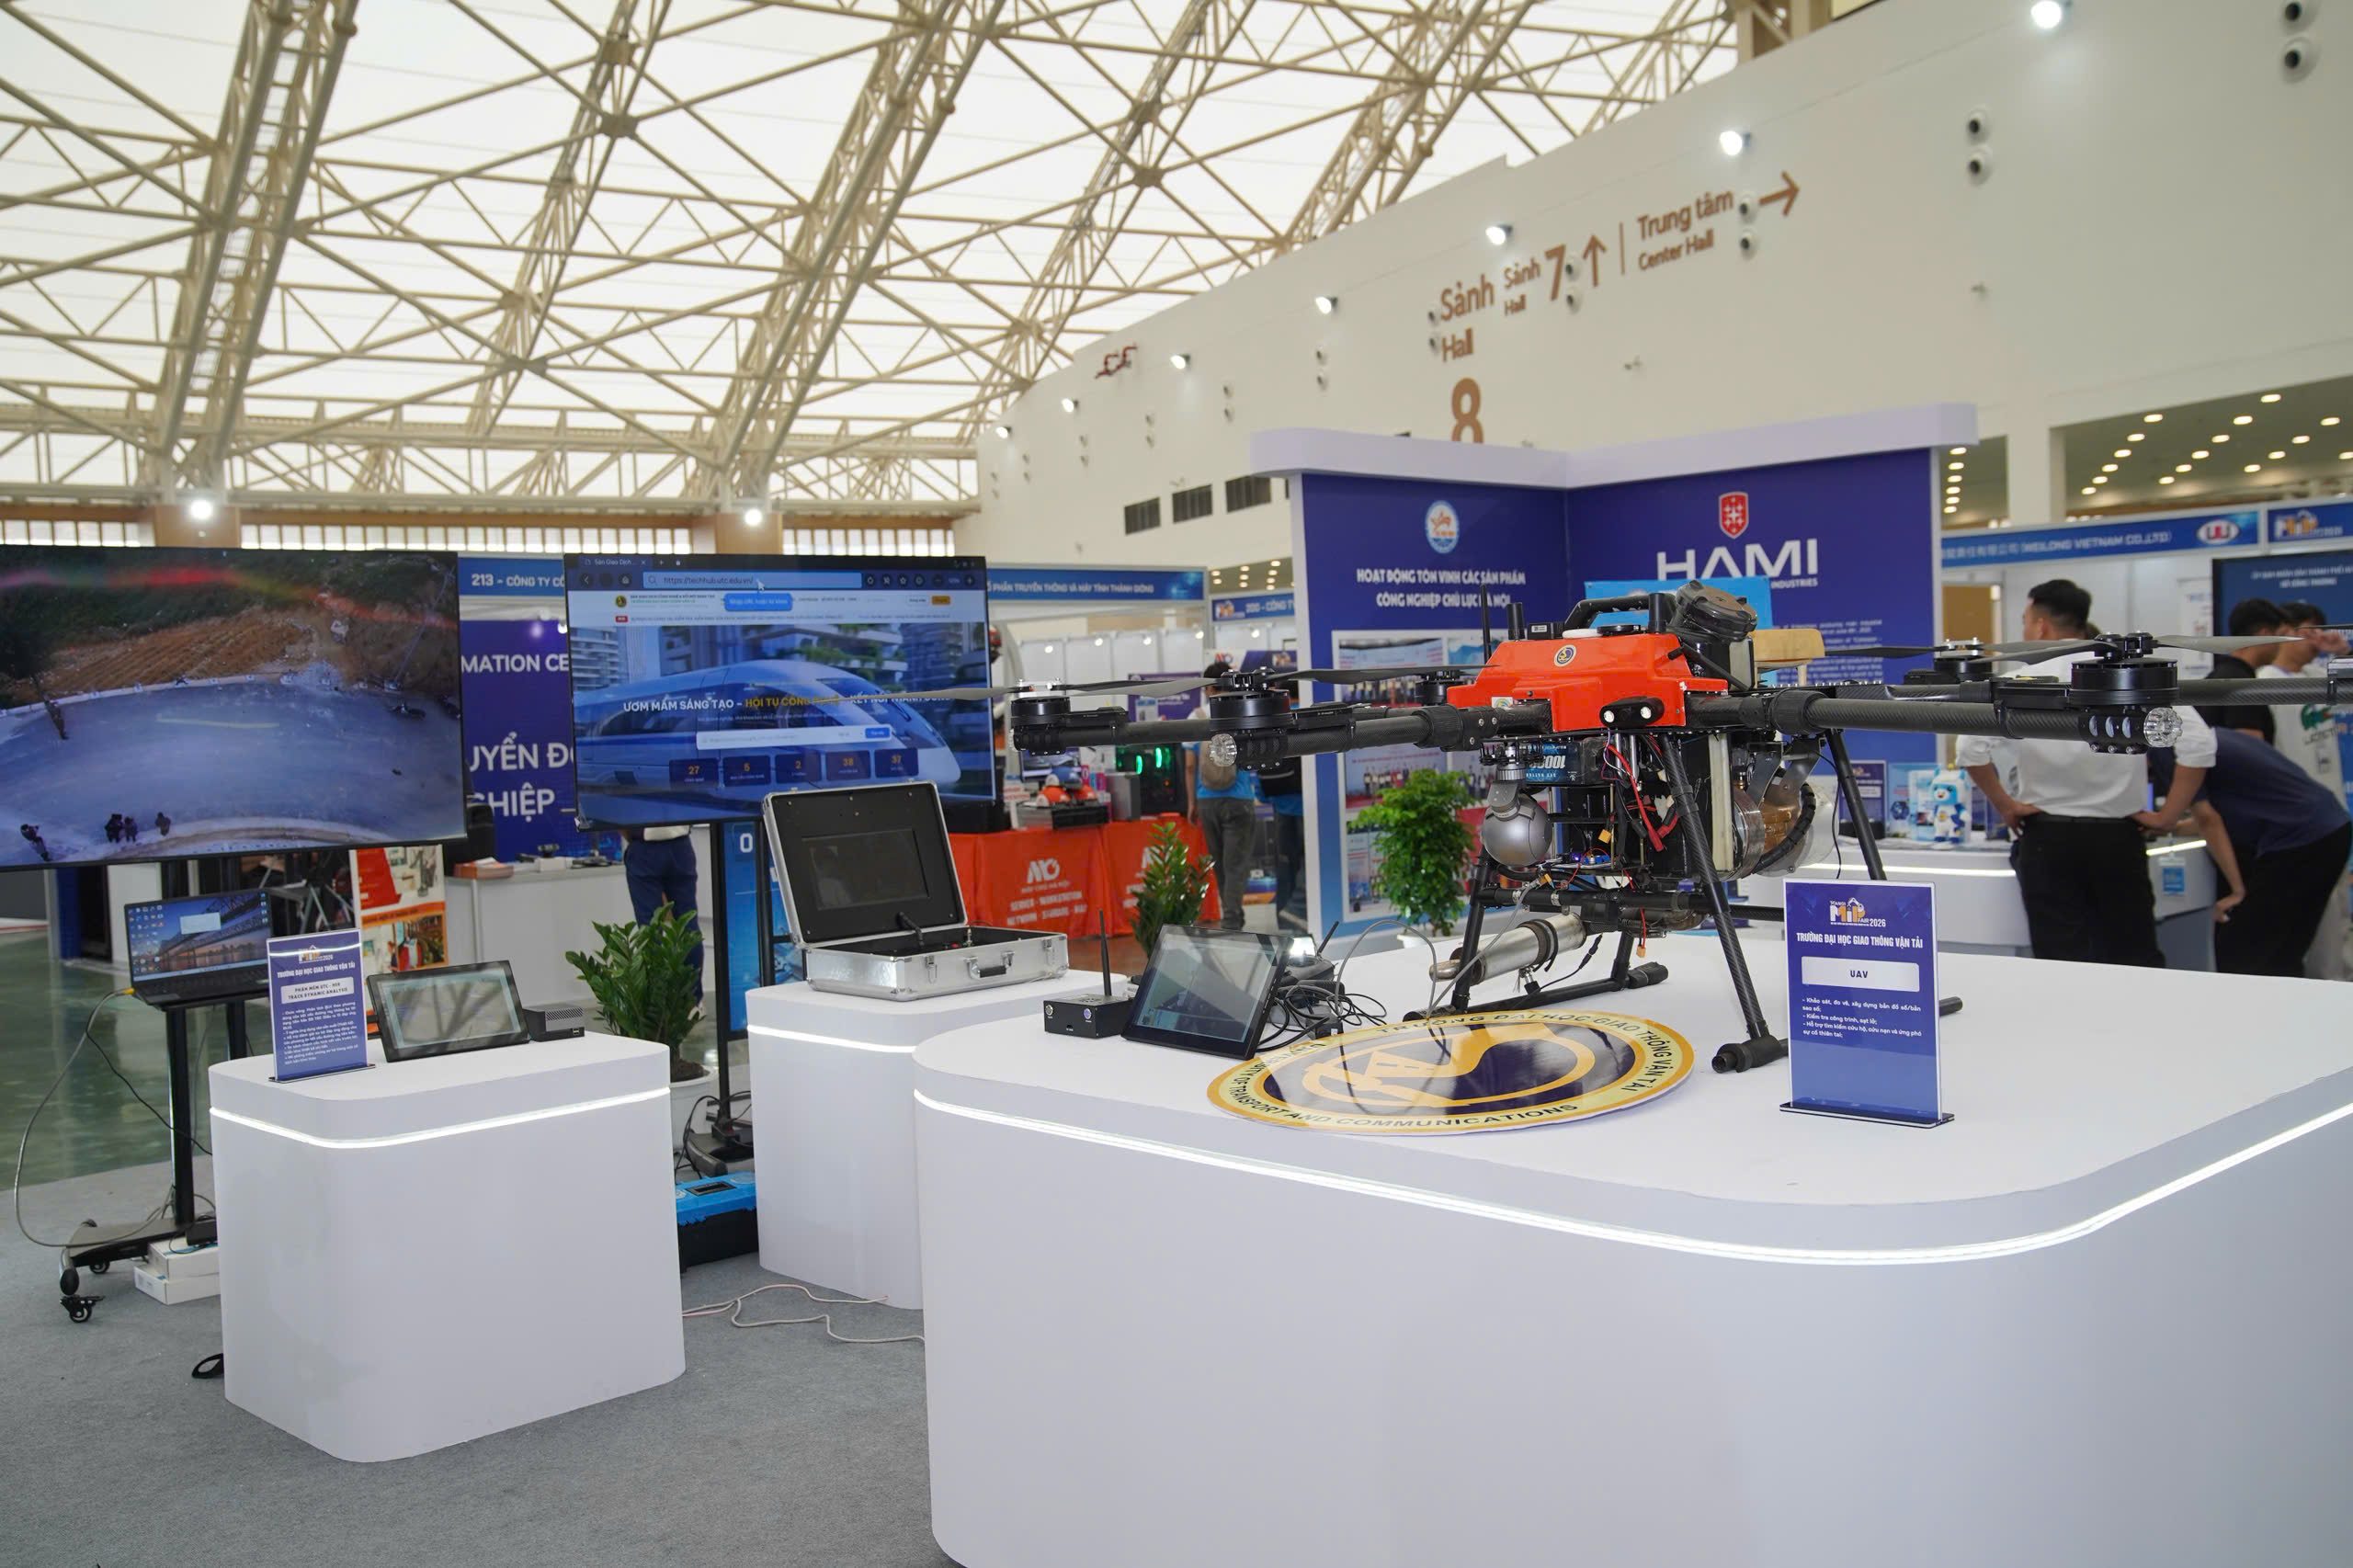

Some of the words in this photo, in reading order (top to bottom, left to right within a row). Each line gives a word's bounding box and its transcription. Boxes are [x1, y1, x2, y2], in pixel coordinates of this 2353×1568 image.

[1637, 206, 1692, 241] Trung
[1695, 189, 1734, 220] tâm
[1639, 245, 1683, 271] Center
[1686, 229, 1714, 254] Hall
[1504, 257, 1541, 290] Sảnh
[1545, 244, 1566, 301] 7
[1440, 274, 1495, 322] Sảnh
[1505, 294, 1526, 317] Hall
[1442, 327, 1474, 363] Hall
[1451, 378, 1484, 444] 8
[1657, 539, 1818, 582] HAMI
[472, 573, 494, 586] 213
[506, 574, 535, 587] CÔNG
[538, 577, 551, 586] TY
[1357, 568, 1386, 585] HOẠT
[1386, 567, 1415, 585] ĐỘNG
[1438, 570, 1461, 584] VINH
[1771, 578, 1818, 589] INDUSTRIES
[1376, 590, 1405, 608] CÔNG
[460, 653, 540, 673] MATION
[545, 653, 569, 672] CE
[711, 699, 734, 711] TẠO
[745, 697, 764, 710] HỘI
[688, 766, 699, 775] 27
[1870, 918, 1886, 927] 2026
[1796, 931, 1824, 943] TRƯỜNG
[1824, 934, 1836, 945] ĐẠI
[1837, 935, 1852, 947] HỌC
[1853, 936, 1870, 946] GIAO
[1870, 935, 1894, 948] THÔNG
[1895, 937, 1910, 949] VẬN
[1911, 936, 1923, 949] TẢI
[1849, 970, 1869, 979] UAV
[1593, 1017, 1640, 1032] GIAO
[1638, 1029, 1673, 1058] THÔNG
[1644, 1059, 1674, 1077] VẬN
[1621, 1077, 1656, 1092] TẢI
[1229, 1085, 1290, 1115] TRANSPORT
[1283, 1111, 1331, 1123] AND
[1336, 1103, 1578, 1127] COMMUNICATIONS
